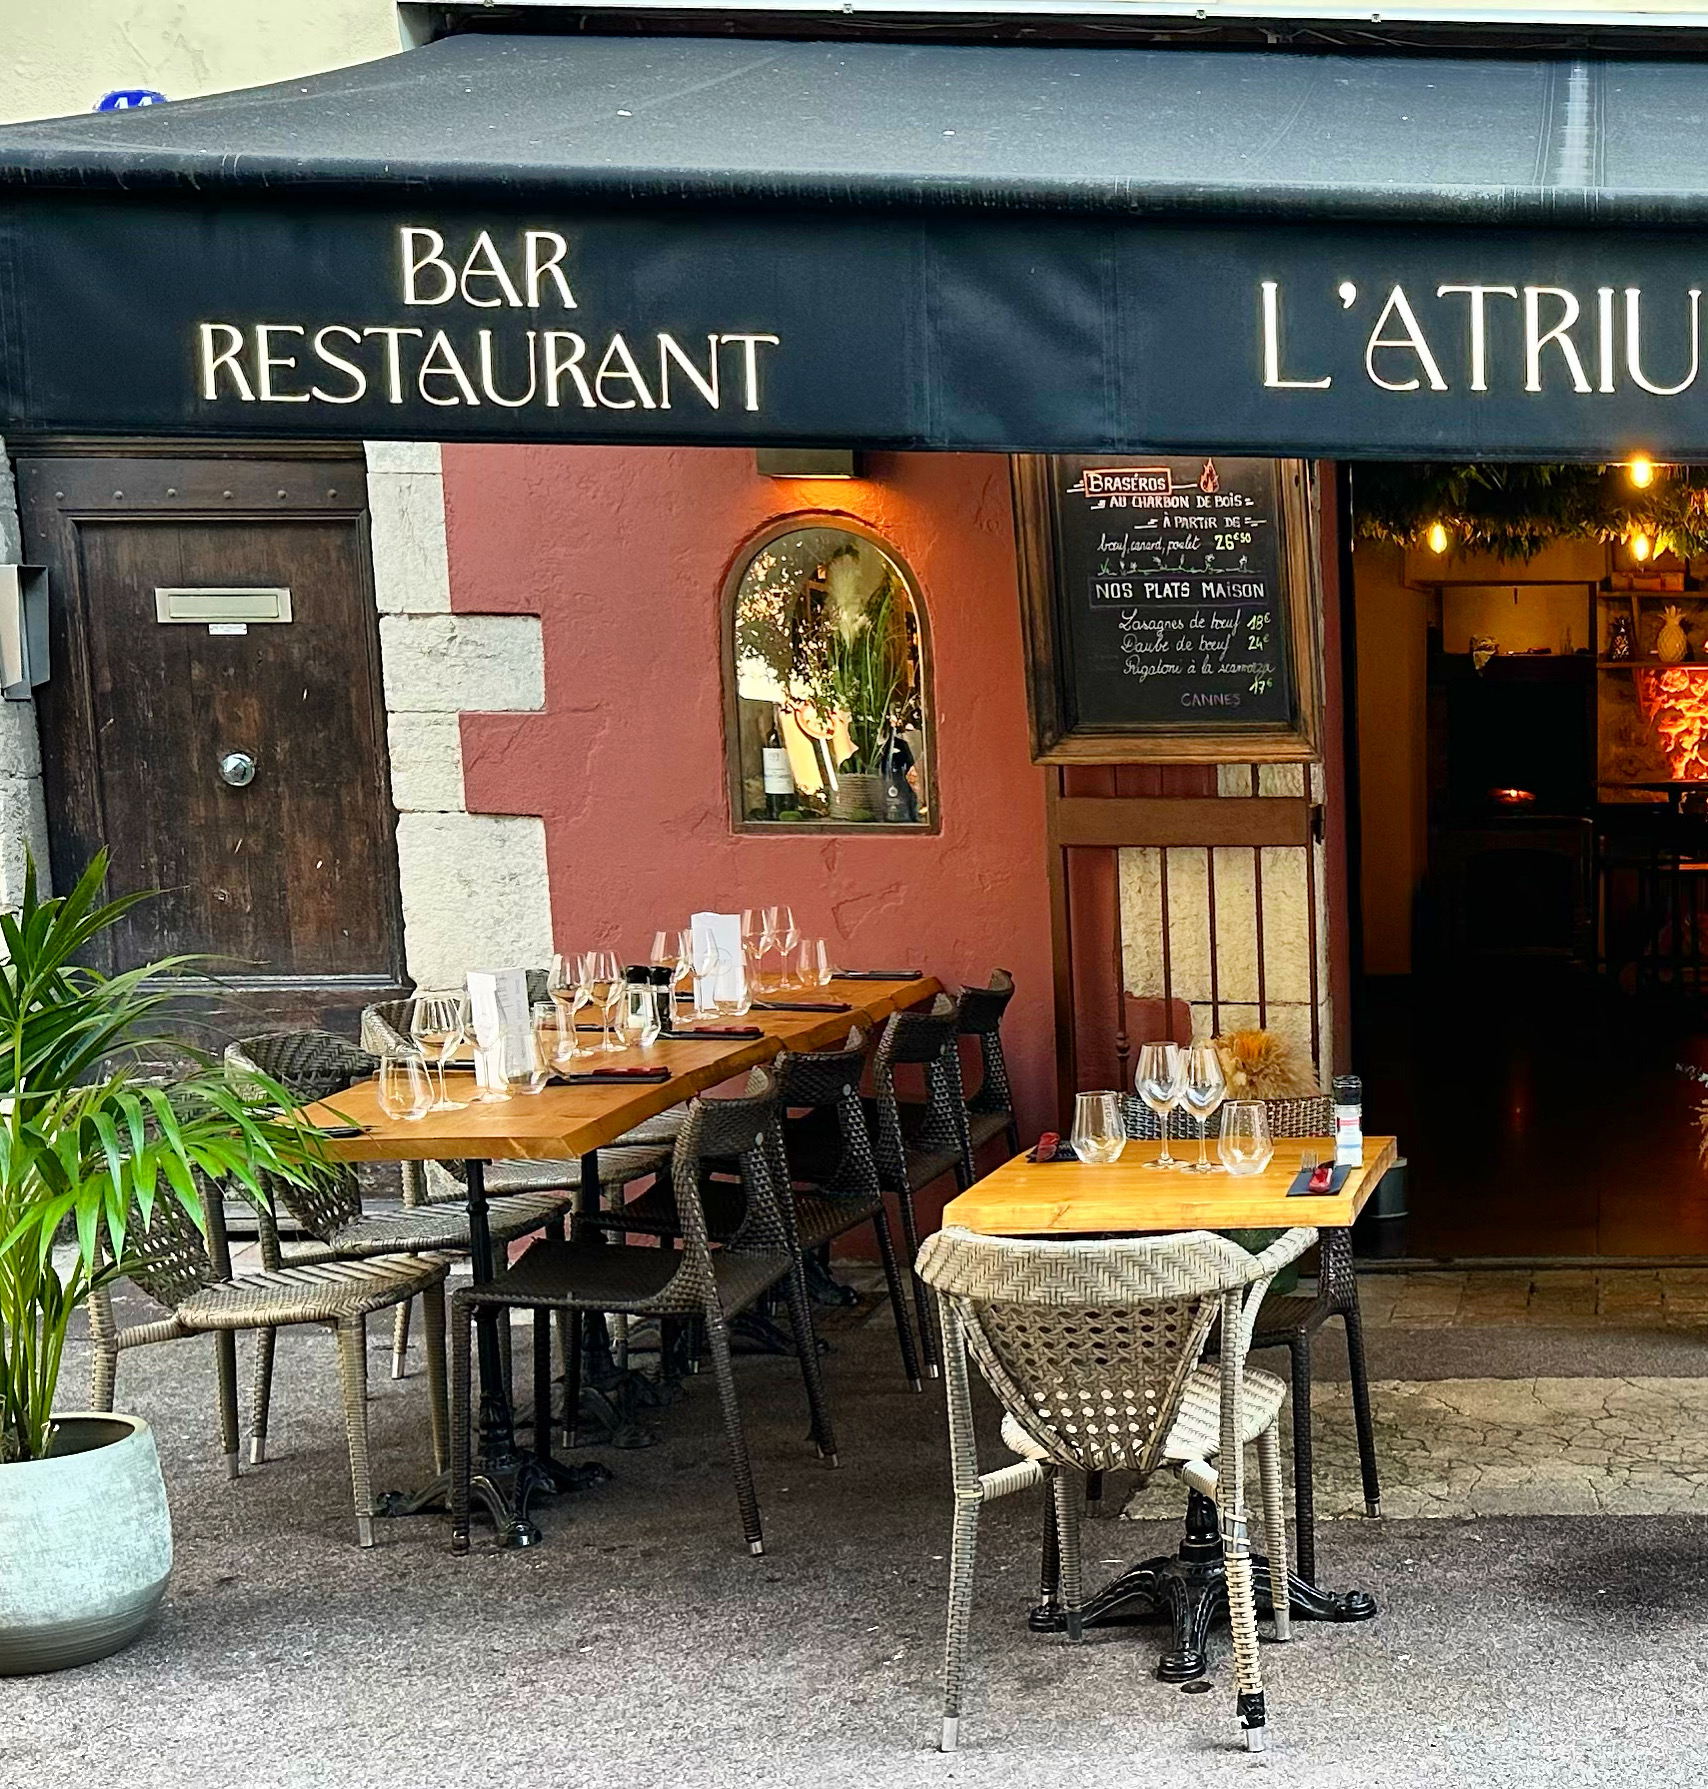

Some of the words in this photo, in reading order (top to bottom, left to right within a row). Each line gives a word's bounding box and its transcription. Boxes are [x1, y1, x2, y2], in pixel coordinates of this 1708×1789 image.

[400, 227, 577, 308] BAR
[199, 323, 780, 411] RESTAURANT
[1109, 496, 1127, 509] AU
[1196, 496, 1212, 508] DE
[1163, 512, 1171, 528] À
[1224, 517, 1240, 528] DE
[1096, 583, 1132, 599] NOS
[1144, 582, 1190, 599] PLATS
[1119, 608, 1184, 637] Lasagnes
[1190, 611, 1206, 630] de
[1121, 633, 1169, 653] Daube
[1176, 635, 1193, 650] de
[1188, 660, 1197, 674] à
[1201, 654, 1214, 674] la
[1181, 693, 1241, 707] CANNES
